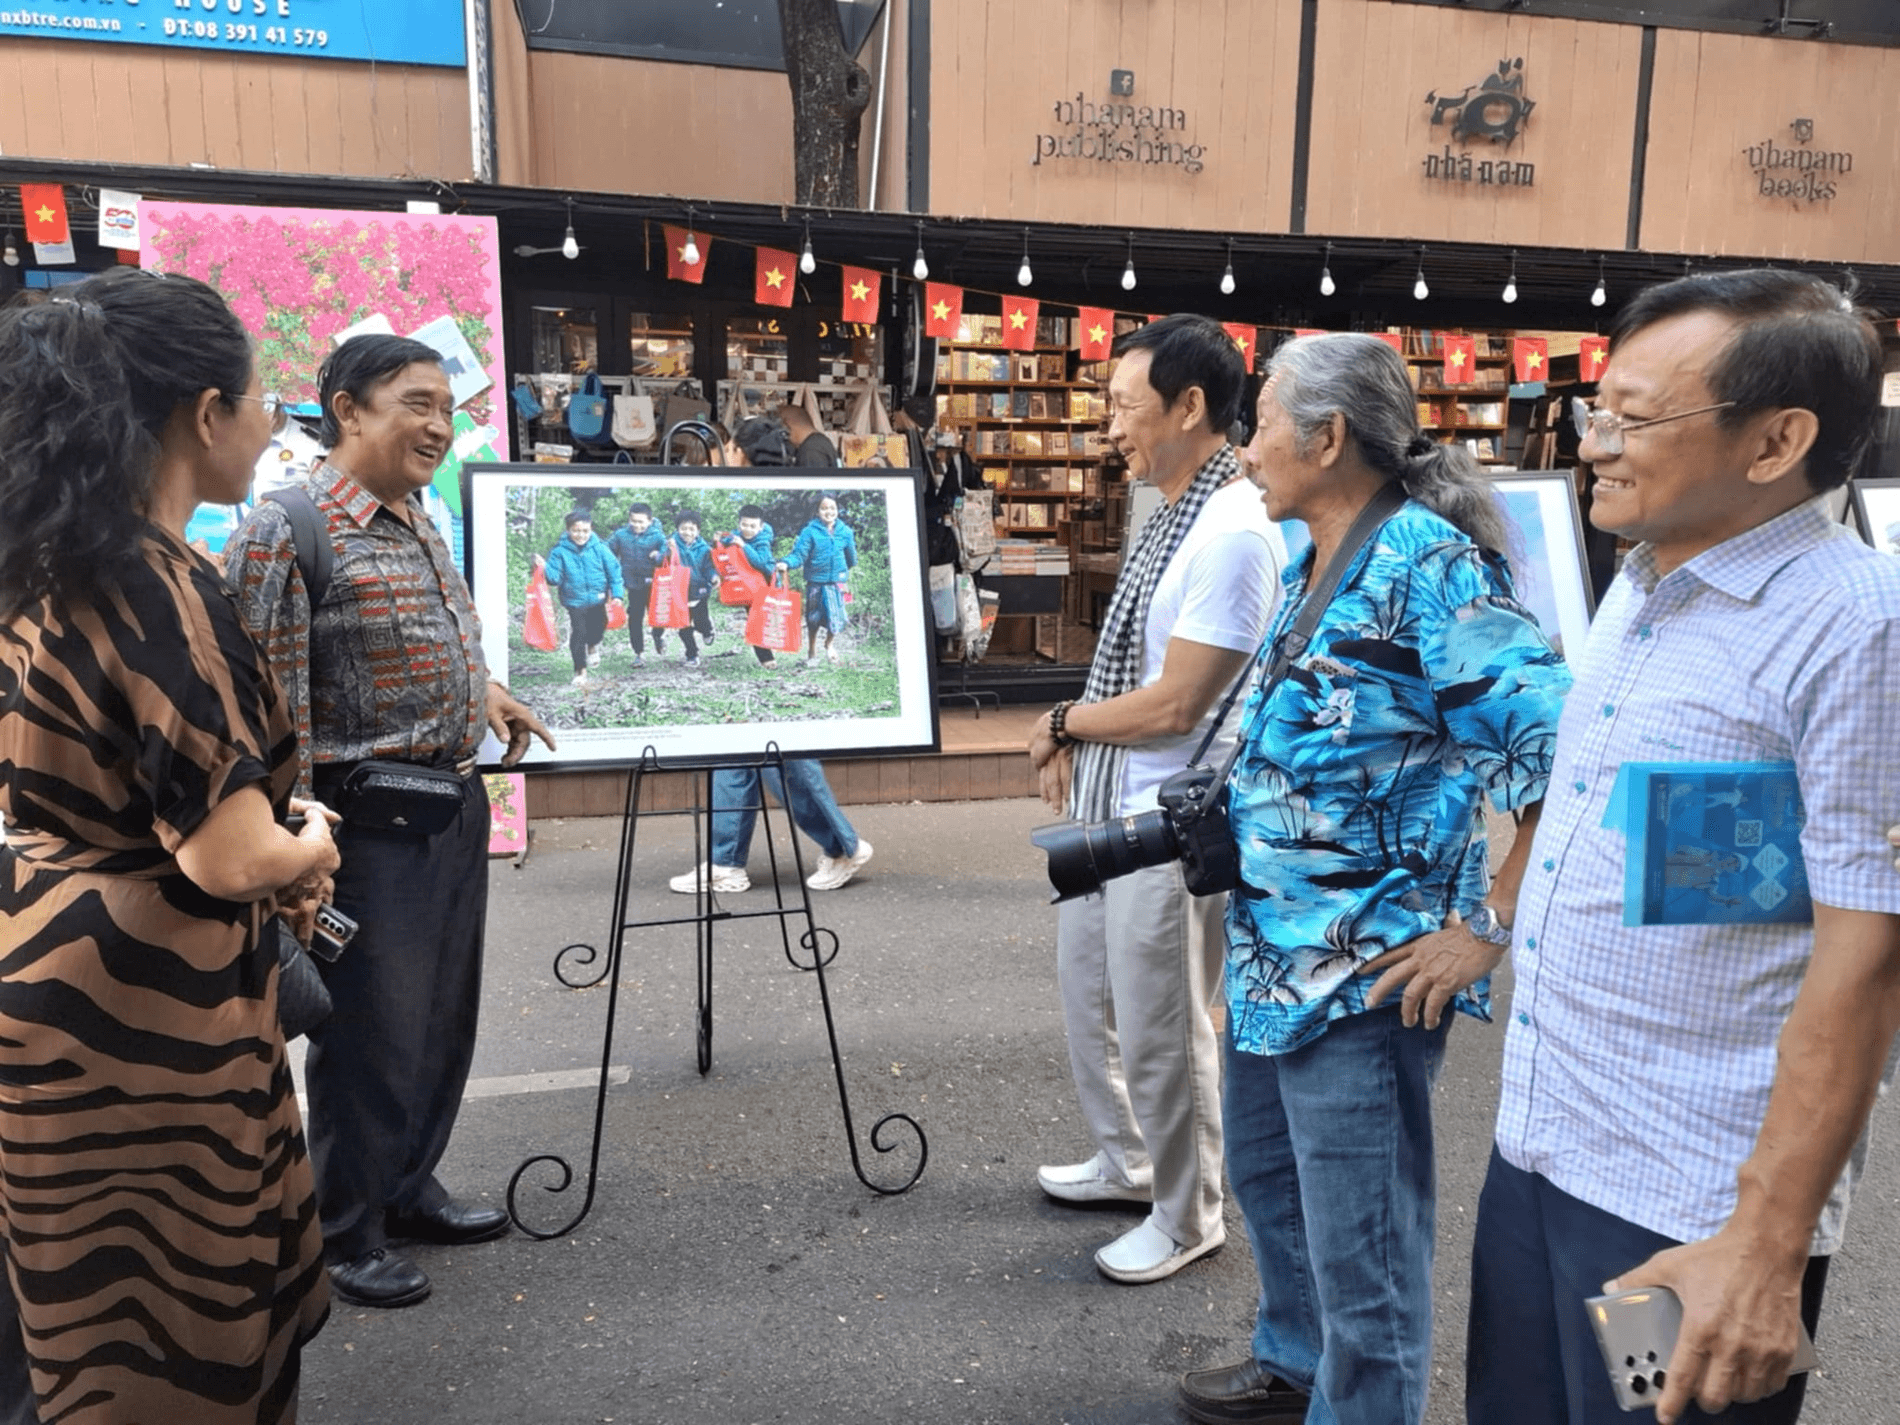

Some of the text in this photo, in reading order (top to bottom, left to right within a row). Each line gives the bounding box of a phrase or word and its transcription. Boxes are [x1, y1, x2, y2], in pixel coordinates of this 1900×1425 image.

[1, 10, 121, 31] nxbtre.com.vn
[225, 23, 258, 42] 391
[265, 26, 286, 44] 41
[293, 28, 328, 47] 579
[1054, 92, 1186, 131] nhanam
[1032, 126, 1208, 174] publishing
[1742, 139, 1853, 175] nhanam
[1477, 160, 1535, 187] nam
[1754, 168, 1838, 203] books
